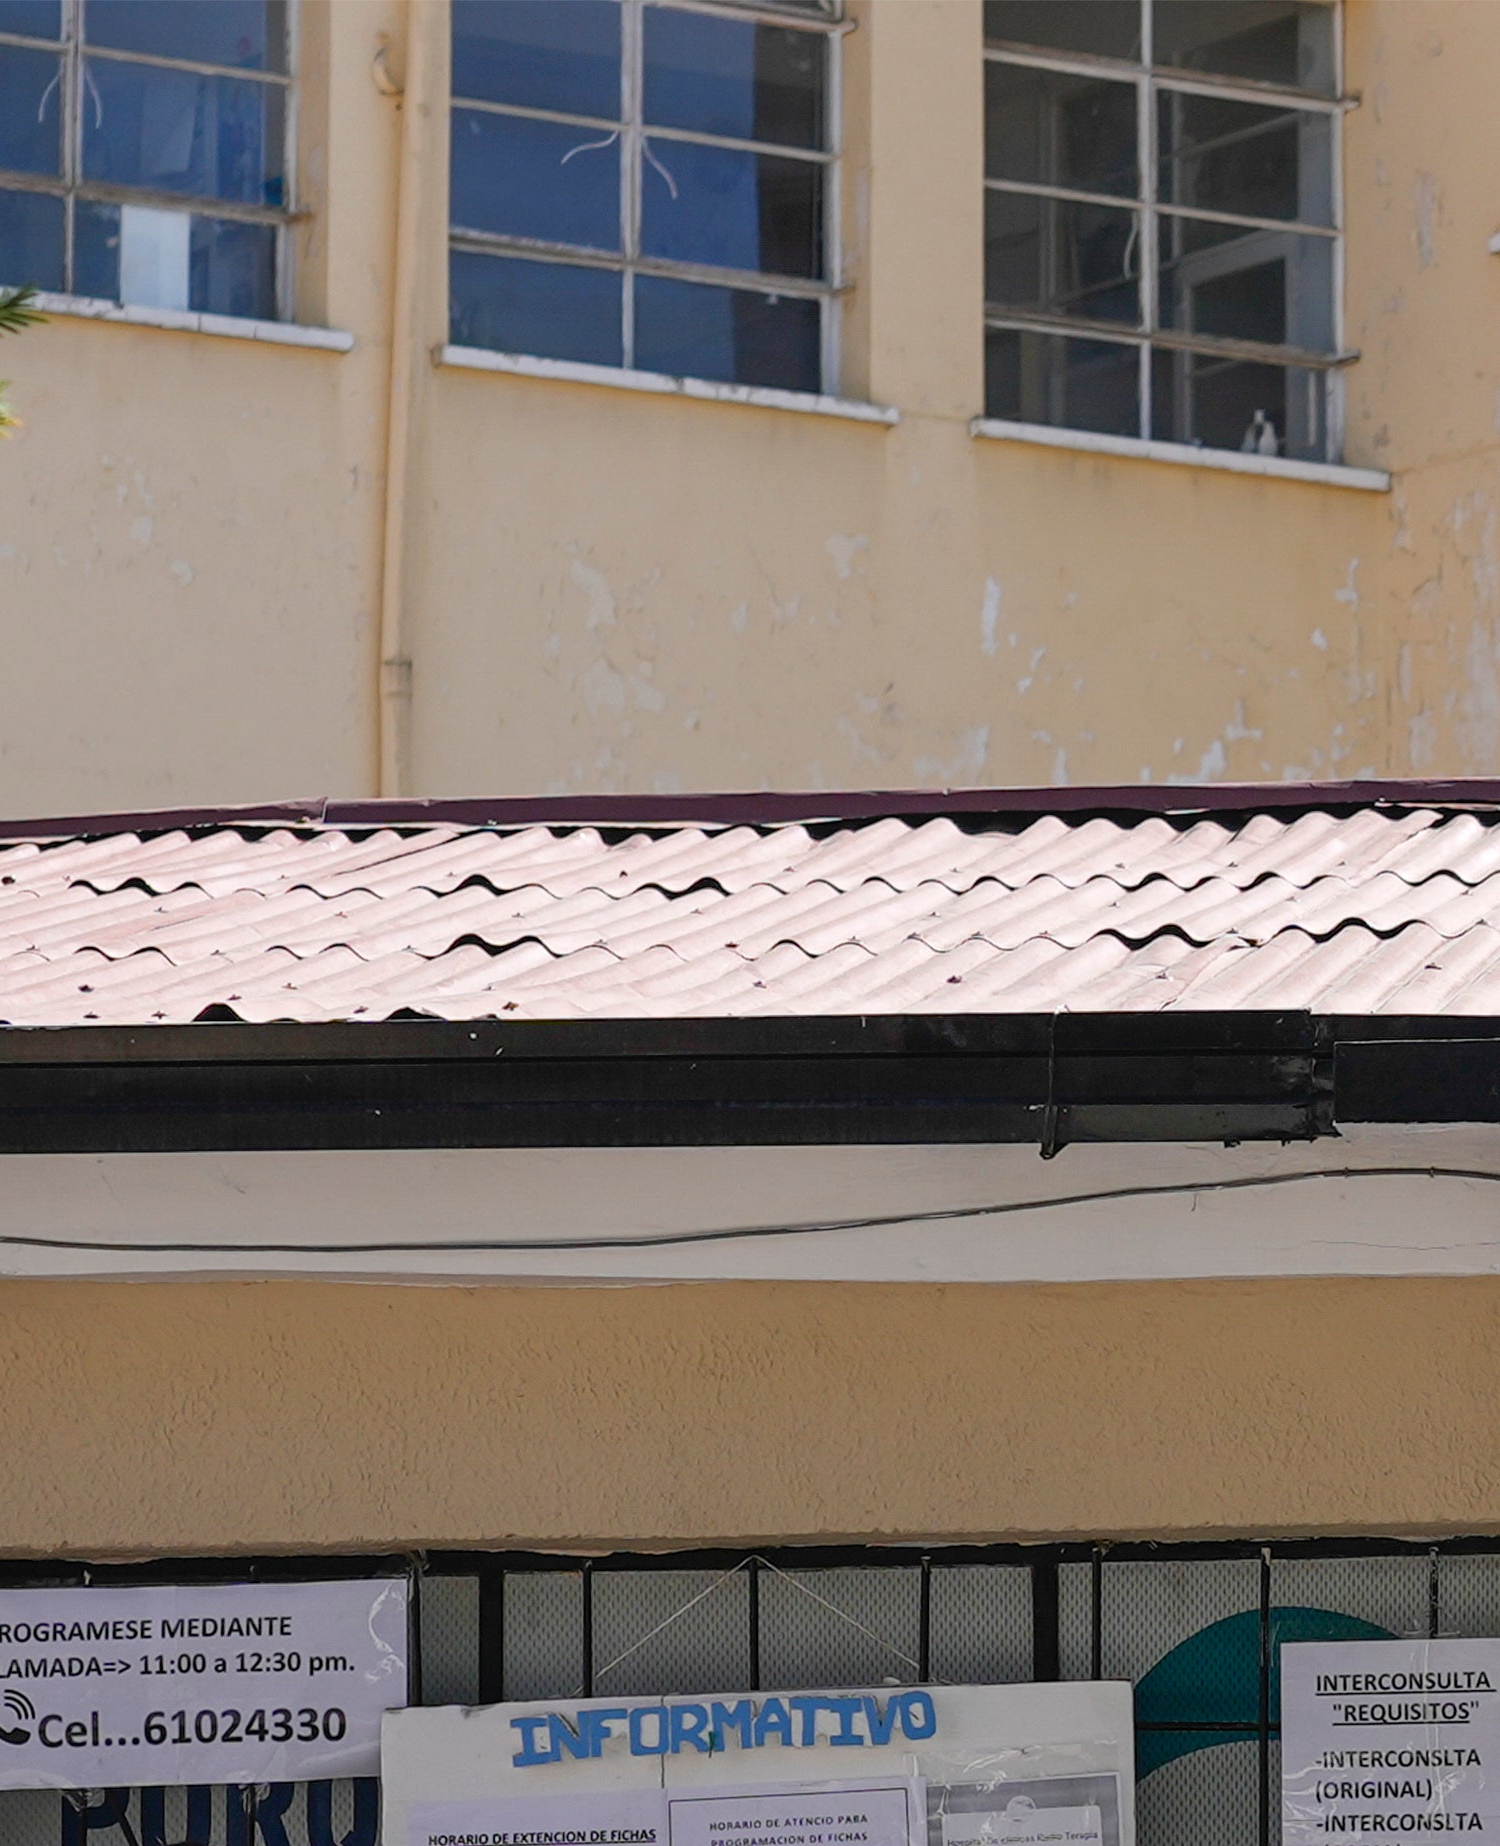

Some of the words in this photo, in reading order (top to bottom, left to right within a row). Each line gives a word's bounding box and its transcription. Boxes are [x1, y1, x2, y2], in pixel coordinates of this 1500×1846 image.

[161, 1616, 292, 1639] MEDIANTE
[141, 1653, 206, 1676] 11:00
[215, 1659, 227, 1675] a
[236, 1651, 301, 1674] 12:30
[309, 1653, 355, 1677] pm.
[1315, 1671, 1490, 1693] INTERCONSULTA
[1331, 1701, 1480, 1722] "REQUISITOS"
[511, 1691, 938, 1768] INFORMATIVO
[1315, 1779, 1434, 1801] (ORIGINAL)
[710, 1820, 761, 1831] HORARIO
[766, 1819, 780, 1828] DE
[784, 1816, 833, 1827] ATENCIO
[429, 1835, 488, 1846] HORARIO
[493, 1834, 510, 1845] DE
[514, 1832, 586, 1843] EXTENCION
[590, 1830, 607, 1841] DE
[611, 1829, 656, 1841] FICHAS
[810, 1834, 823, 1844] DE
[828, 1832, 868, 1842] FICHAS
